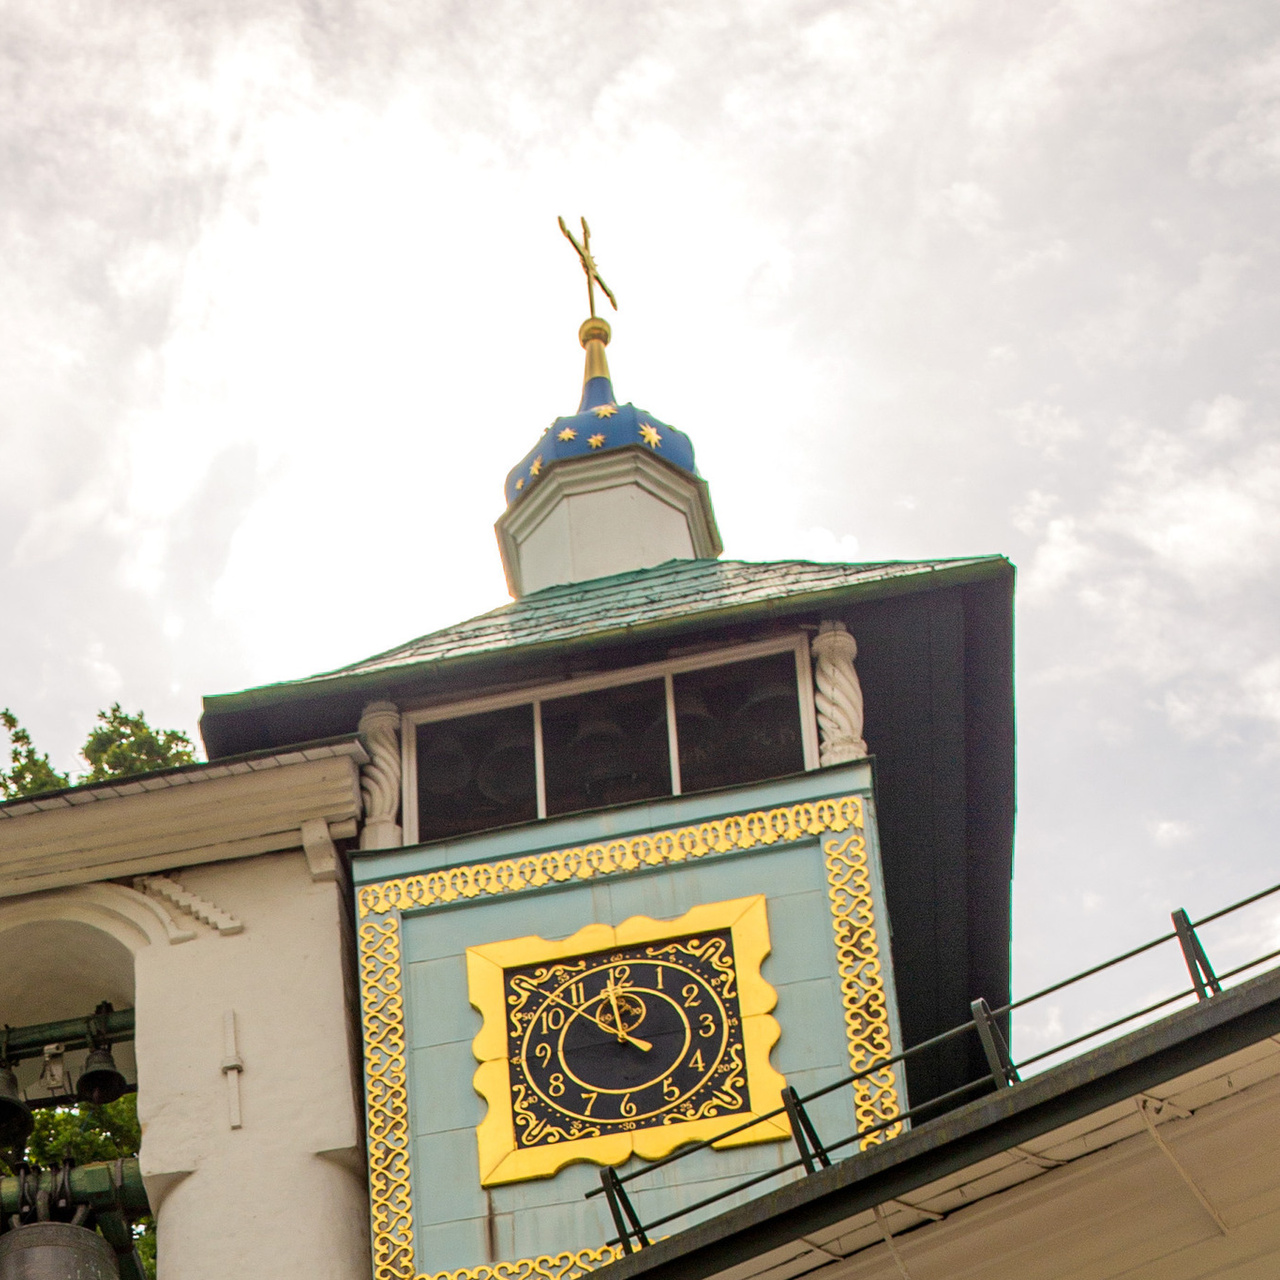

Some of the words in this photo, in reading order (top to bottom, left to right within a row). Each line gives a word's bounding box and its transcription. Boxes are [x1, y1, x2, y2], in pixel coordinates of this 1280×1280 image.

[669, 954, 677, 963] 5
[608, 966, 633, 988] 12
[655, 966, 664, 990] 1
[570, 982, 585, 1007] 11
[682, 984, 702, 1008] 2
[521, 1012, 534, 1021] 50
[541, 1008, 565, 1034] 10
[699, 1014, 716, 1037] 3
[535, 1043, 551, 1069] 9
[689, 1049, 705, 1072] 4
[548, 1073, 565, 1097] 8
[663, 1078, 681, 1101] 5
[581, 1092, 598, 1116] 7
[620, 1093, 637, 1117] 6
